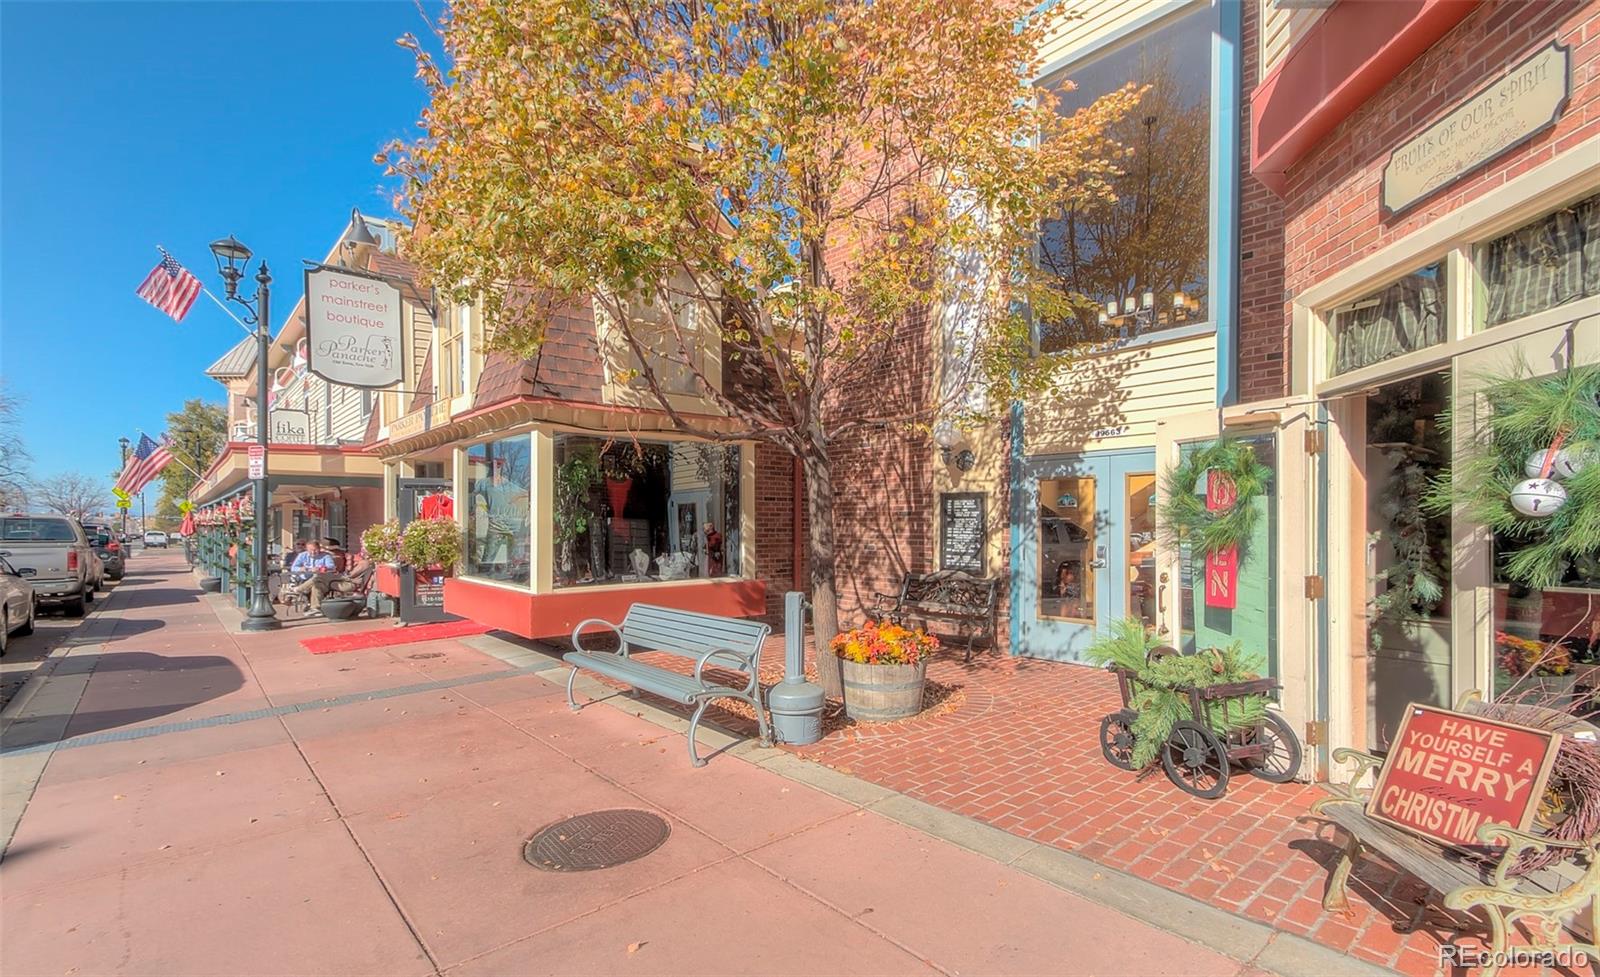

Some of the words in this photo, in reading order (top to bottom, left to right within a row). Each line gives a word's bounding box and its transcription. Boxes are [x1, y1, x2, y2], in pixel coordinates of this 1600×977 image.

[1393, 136, 1435, 176] FRUITS
[1438, 121, 1457, 147] OF
[1460, 97, 1494, 132] OUR
[1499, 56, 1551, 108] SPIRIT
[329, 279, 380, 296] parker's
[321, 295, 388, 313] mainstreet
[326, 311, 385, 329] boutique
[317, 340, 377, 363] Panache
[338, 335, 386, 356] Parker
[276, 420, 305, 434] fika
[1439, 719, 1508, 747] HAVE
[1409, 730, 1513, 768] YOURSELF
[1516, 758, 1534, 776] A
[1395, 746, 1530, 803] MERRY
[1380, 784, 1512, 847] CHRISTM
